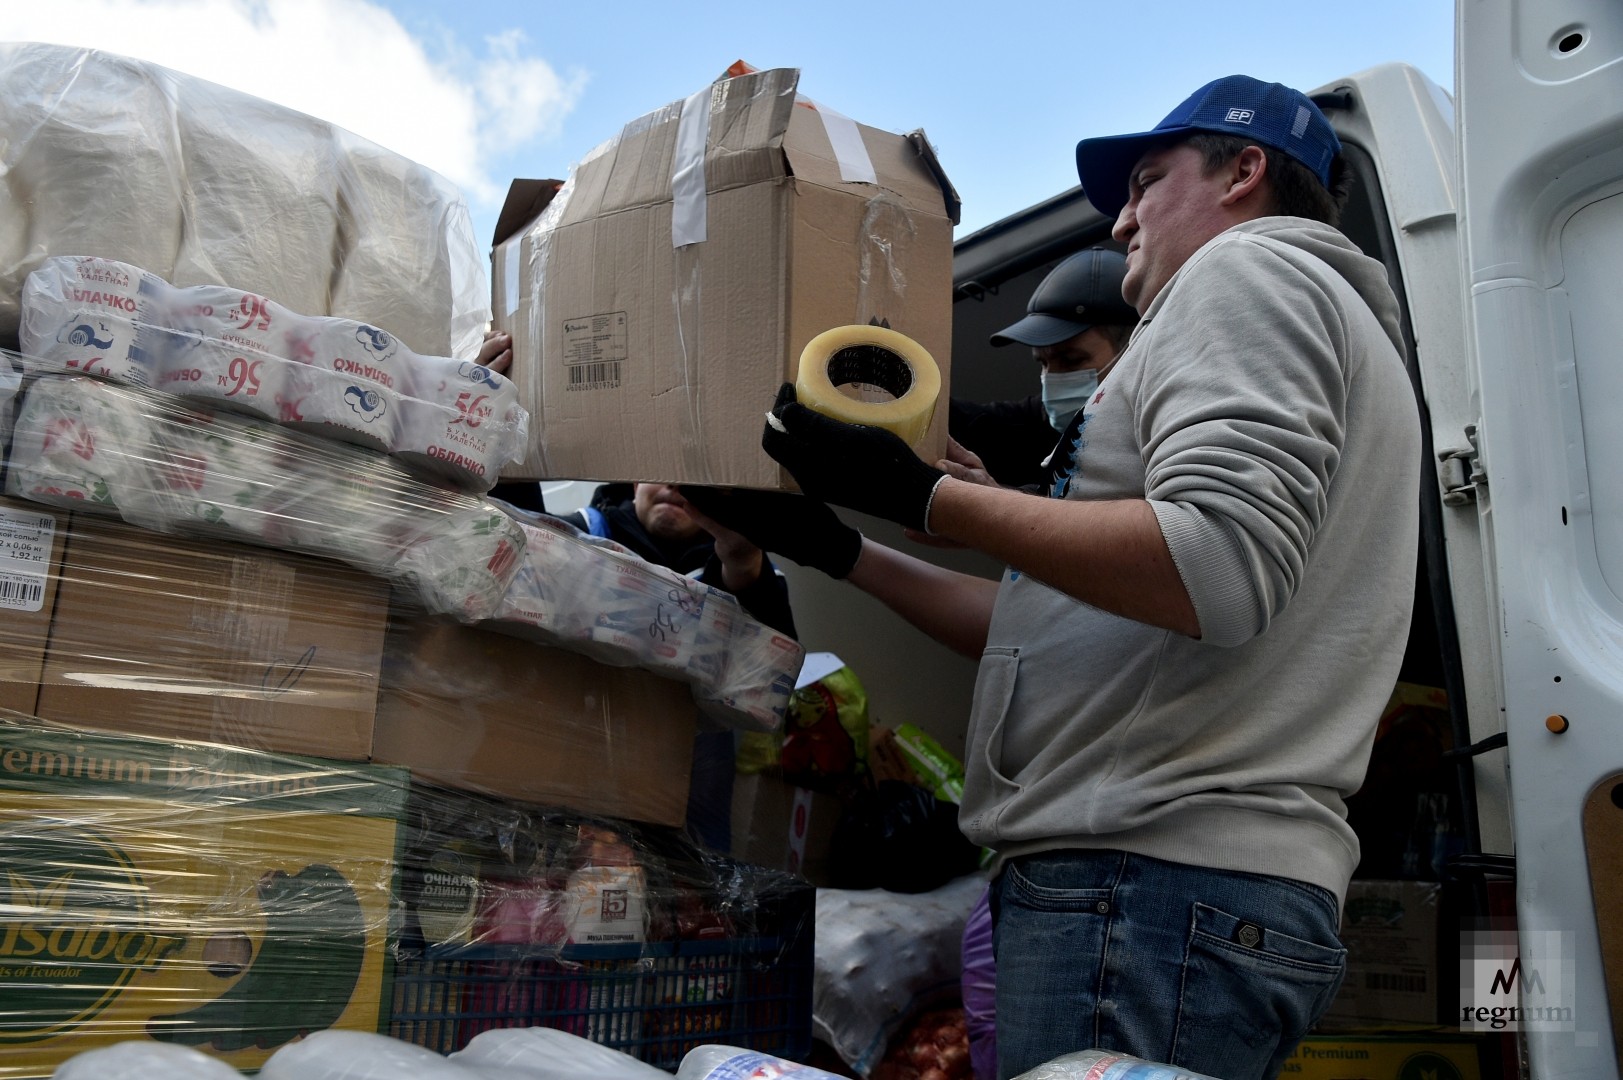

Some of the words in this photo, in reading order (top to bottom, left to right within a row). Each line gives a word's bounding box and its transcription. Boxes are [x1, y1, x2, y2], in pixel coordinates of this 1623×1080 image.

[1228, 110, 1251, 120] EP
[224, 357, 264, 397] 56
[448, 392, 489, 428] 56
[447, 427, 487, 448] БУМАГА
[426, 445, 486, 477] ОБЛАЧКО
[13, 542, 32, 551] 0,06
[0, 745, 149, 783] emium
[15, 965, 31, 977] of
[31, 965, 83, 978] Ecuador
[1303, 1045, 1369, 1059] Premium
